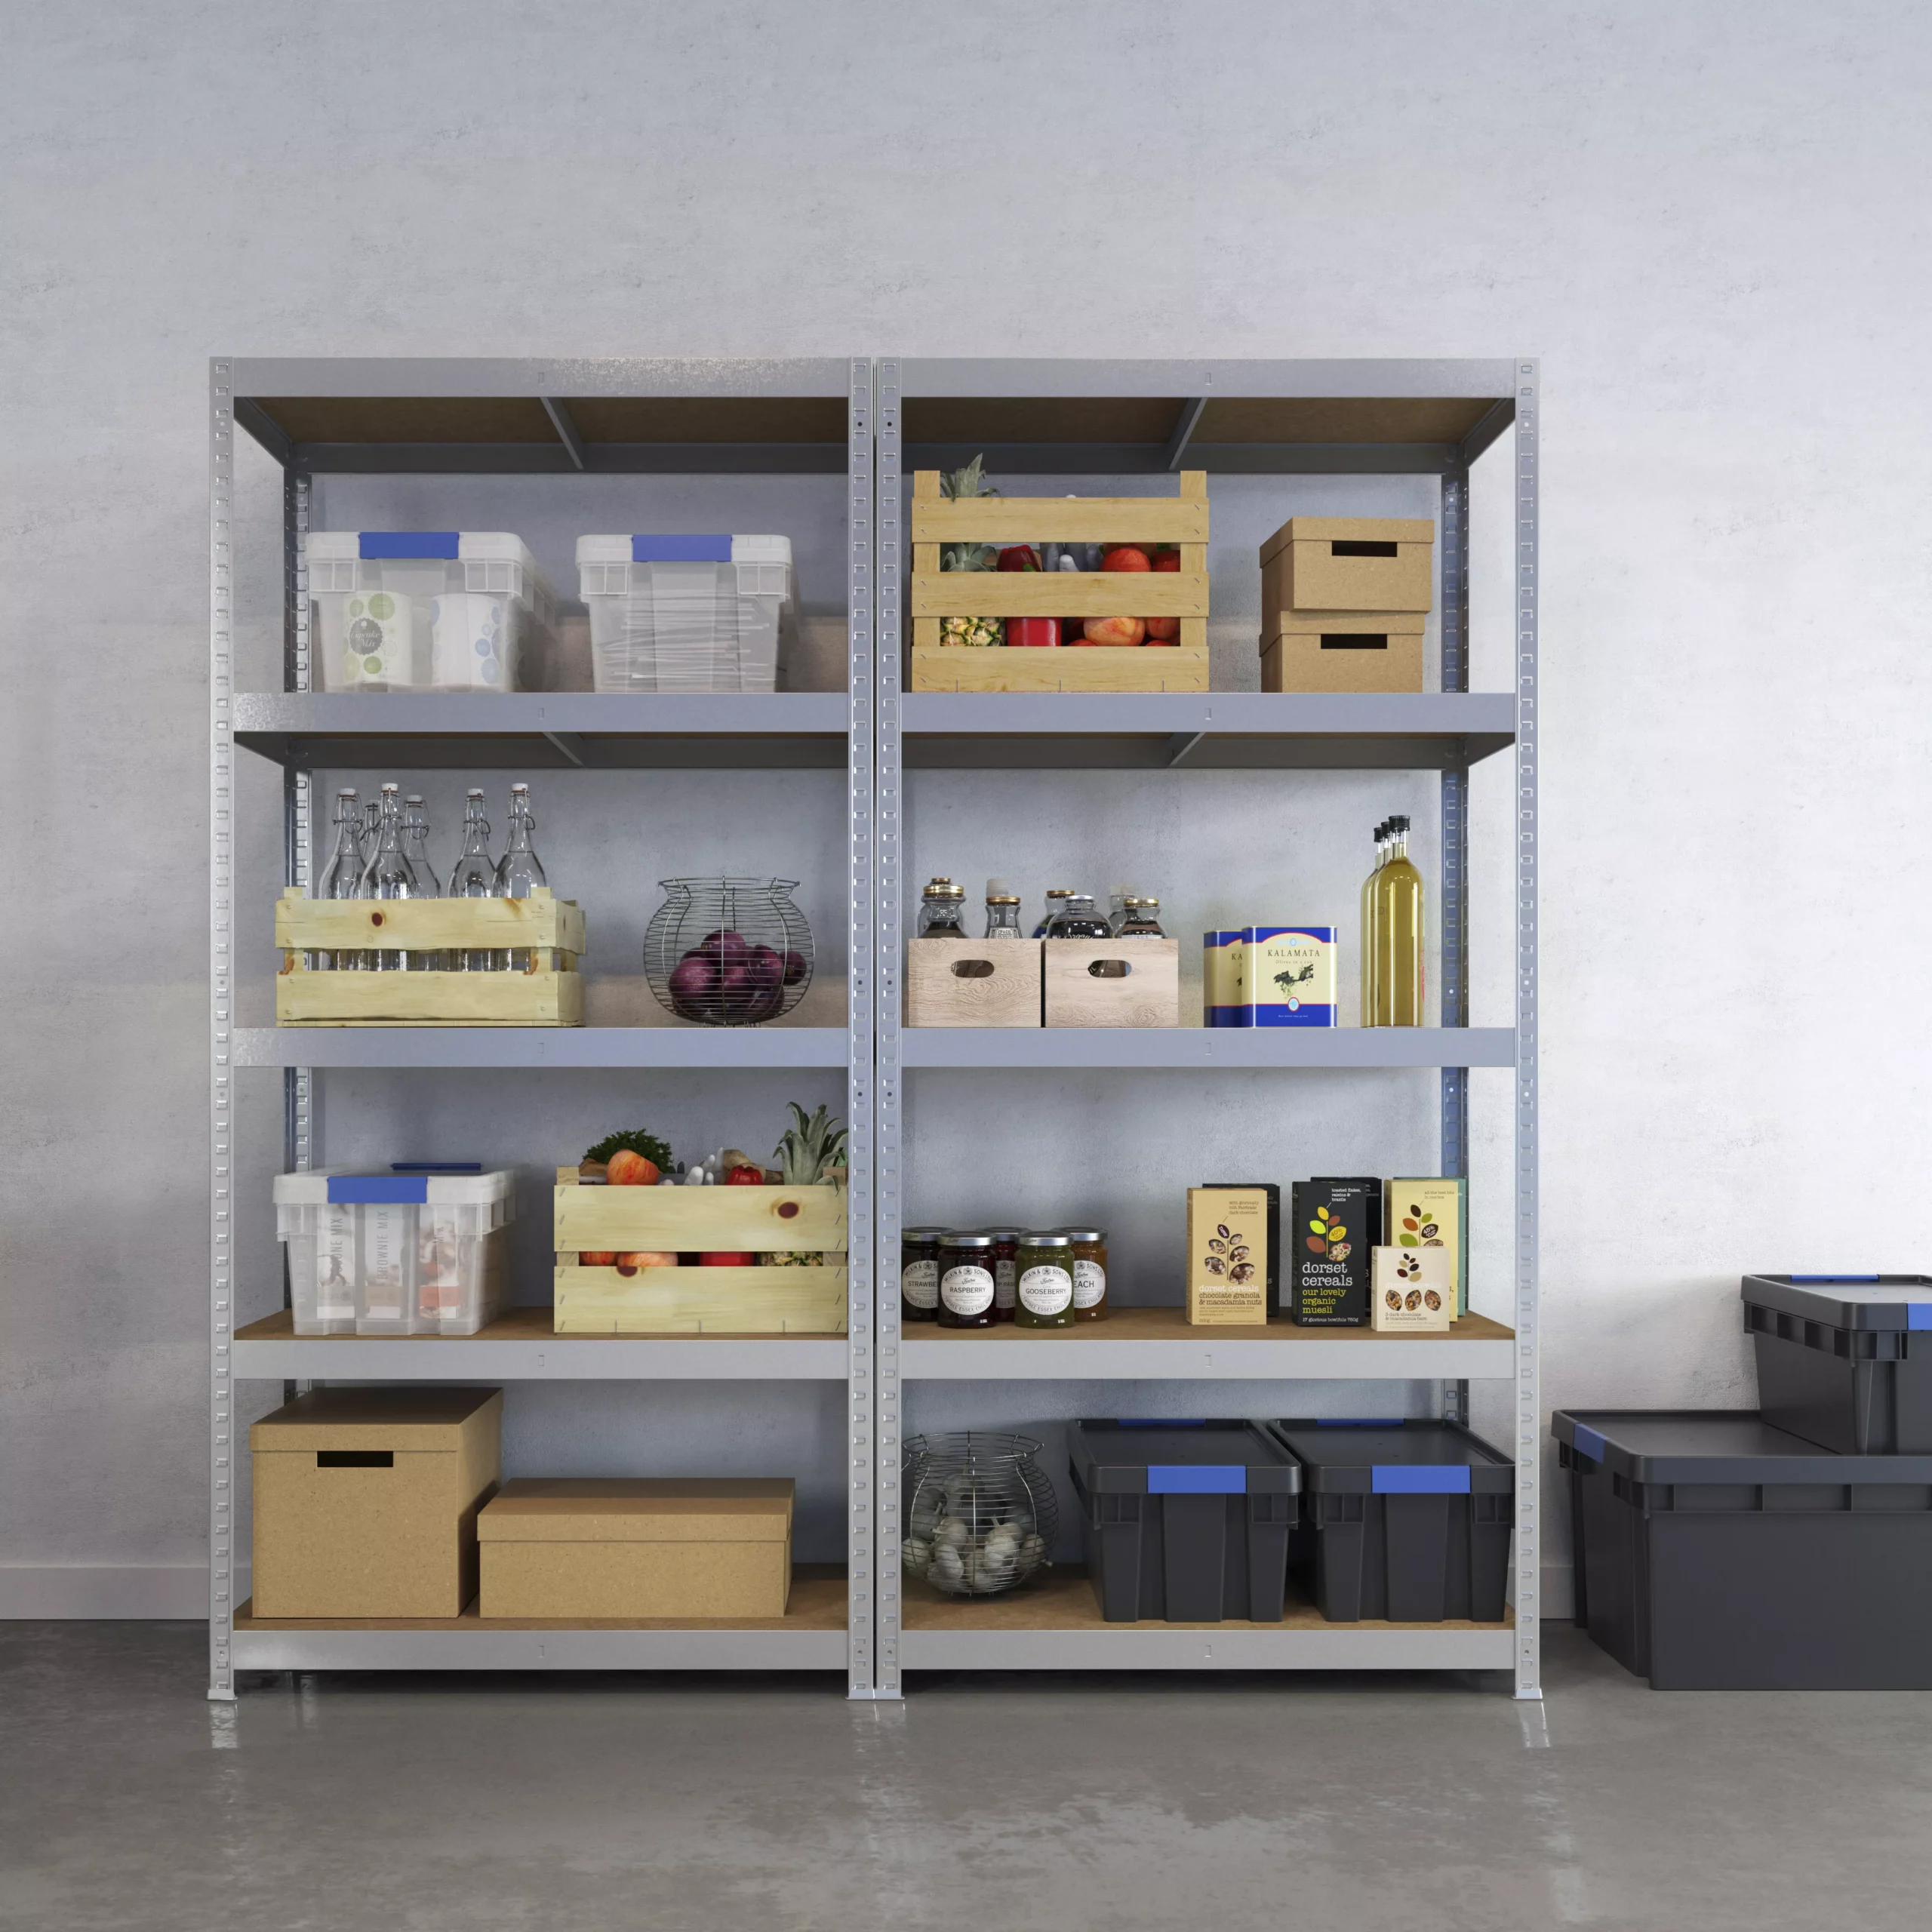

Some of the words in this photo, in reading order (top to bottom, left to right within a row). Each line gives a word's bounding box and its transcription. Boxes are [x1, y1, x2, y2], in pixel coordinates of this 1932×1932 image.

[330, 1217, 343, 1235] MIX
[377, 1211, 388, 1229] MIX
[1218, 1226, 1229, 1238] new
[1331, 1228, 1343, 1237] 40%
[377, 1234, 388, 1280] BROWNIE
[1302, 1262, 1348, 1274] dorset
[944, 1270, 957, 1282] WILKIN
[974, 1269, 986, 1277] SONS
[1023, 1270, 1036, 1282] WILKIN
[1052, 1269, 1064, 1277] SONS
[1302, 1275, 1353, 1286] cereals
[1073, 1280, 1094, 1288] EACH
[1319, 1288, 1346, 1297] lovely
[1302, 1297, 1337, 1306] organic
[1302, 1306, 1333, 1314] muesli
